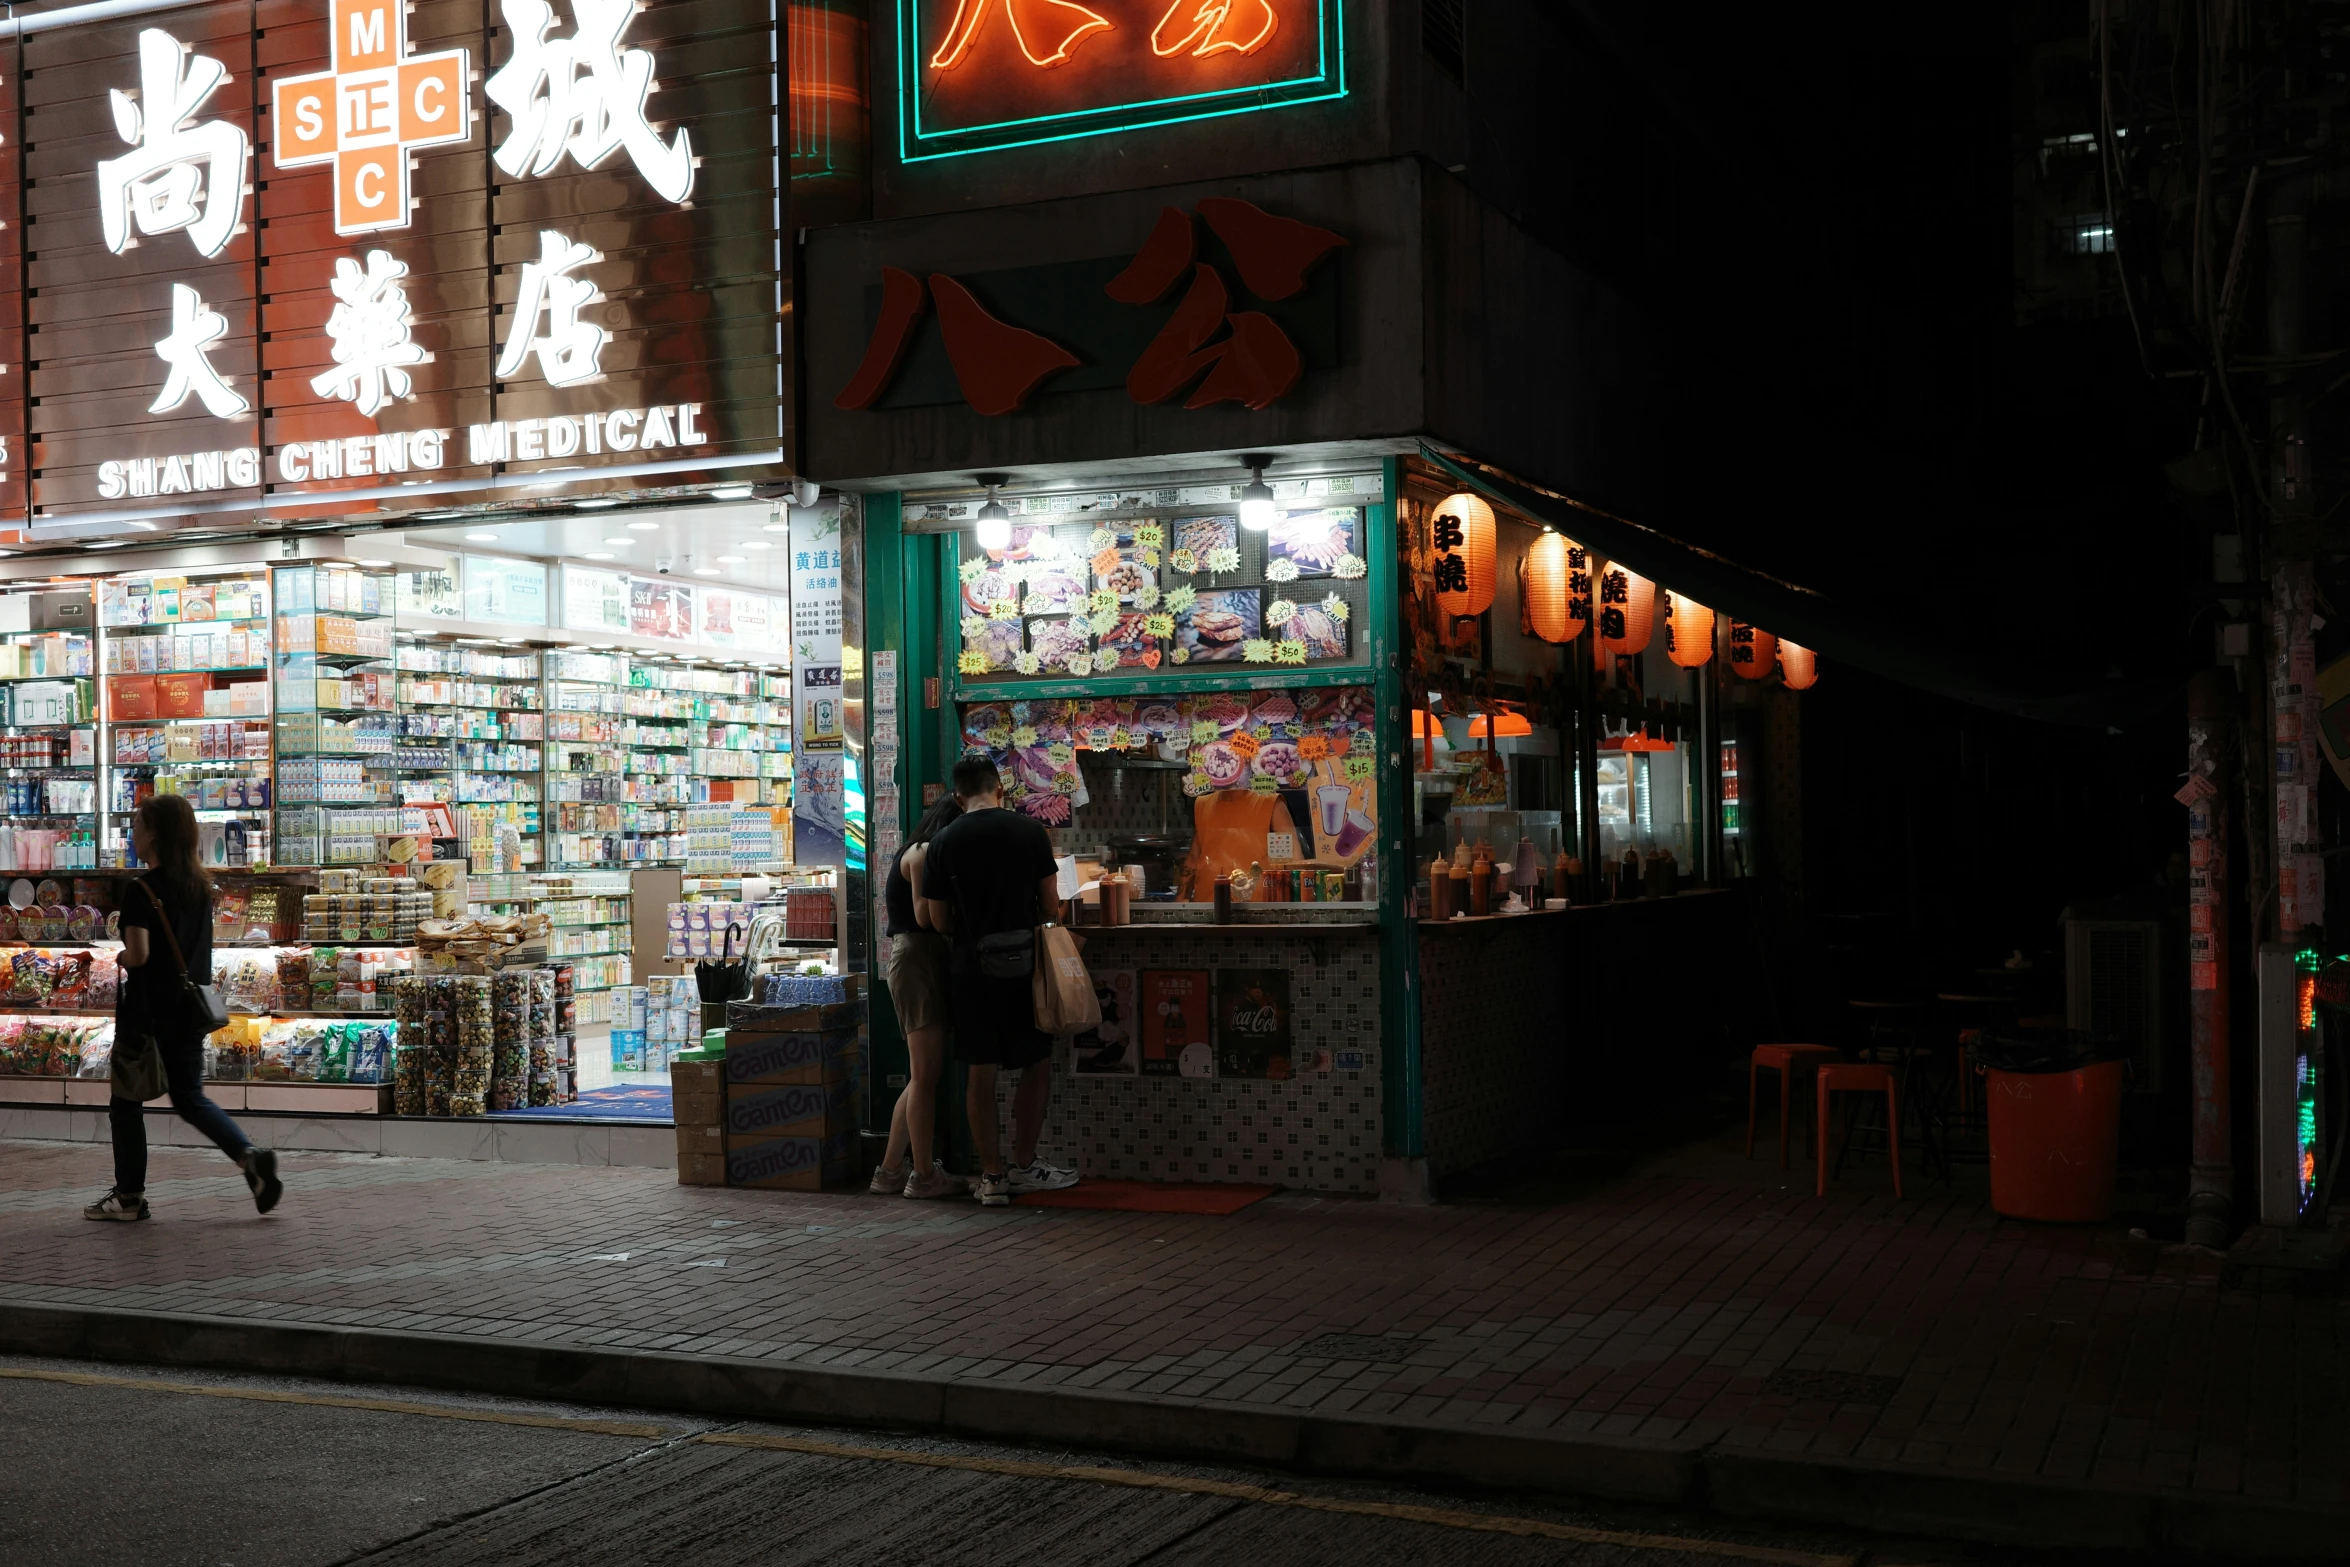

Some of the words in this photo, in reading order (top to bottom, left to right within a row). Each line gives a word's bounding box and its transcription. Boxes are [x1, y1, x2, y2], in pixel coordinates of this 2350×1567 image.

[350, 8, 385, 57] M
[295, 95, 323, 141] S
[414, 76, 446, 122] C
[98, 28, 248, 258] 尚
[485, 0, 696, 204] 城
[355, 162, 386, 208] C
[833, 198, 1349, 416] 八公
[97, 446, 261, 501] SHANG
[278, 428, 446, 483] CHENG
[469, 402, 708, 465] MEDICAL
[1139, 531, 1158, 541] $20
[1433, 513, 1469, 594] 串燒
[995, 603, 1012, 615] $20
[1149, 620, 1167, 631] $25
[1281, 647, 1299, 657] $50
[965, 658, 982, 667] $25
[878, 671, 893, 680] $598
[877, 744, 893, 752] $598
[1350, 762, 1369, 776] $15
[1203, 1065, 1211, 1074] 支
